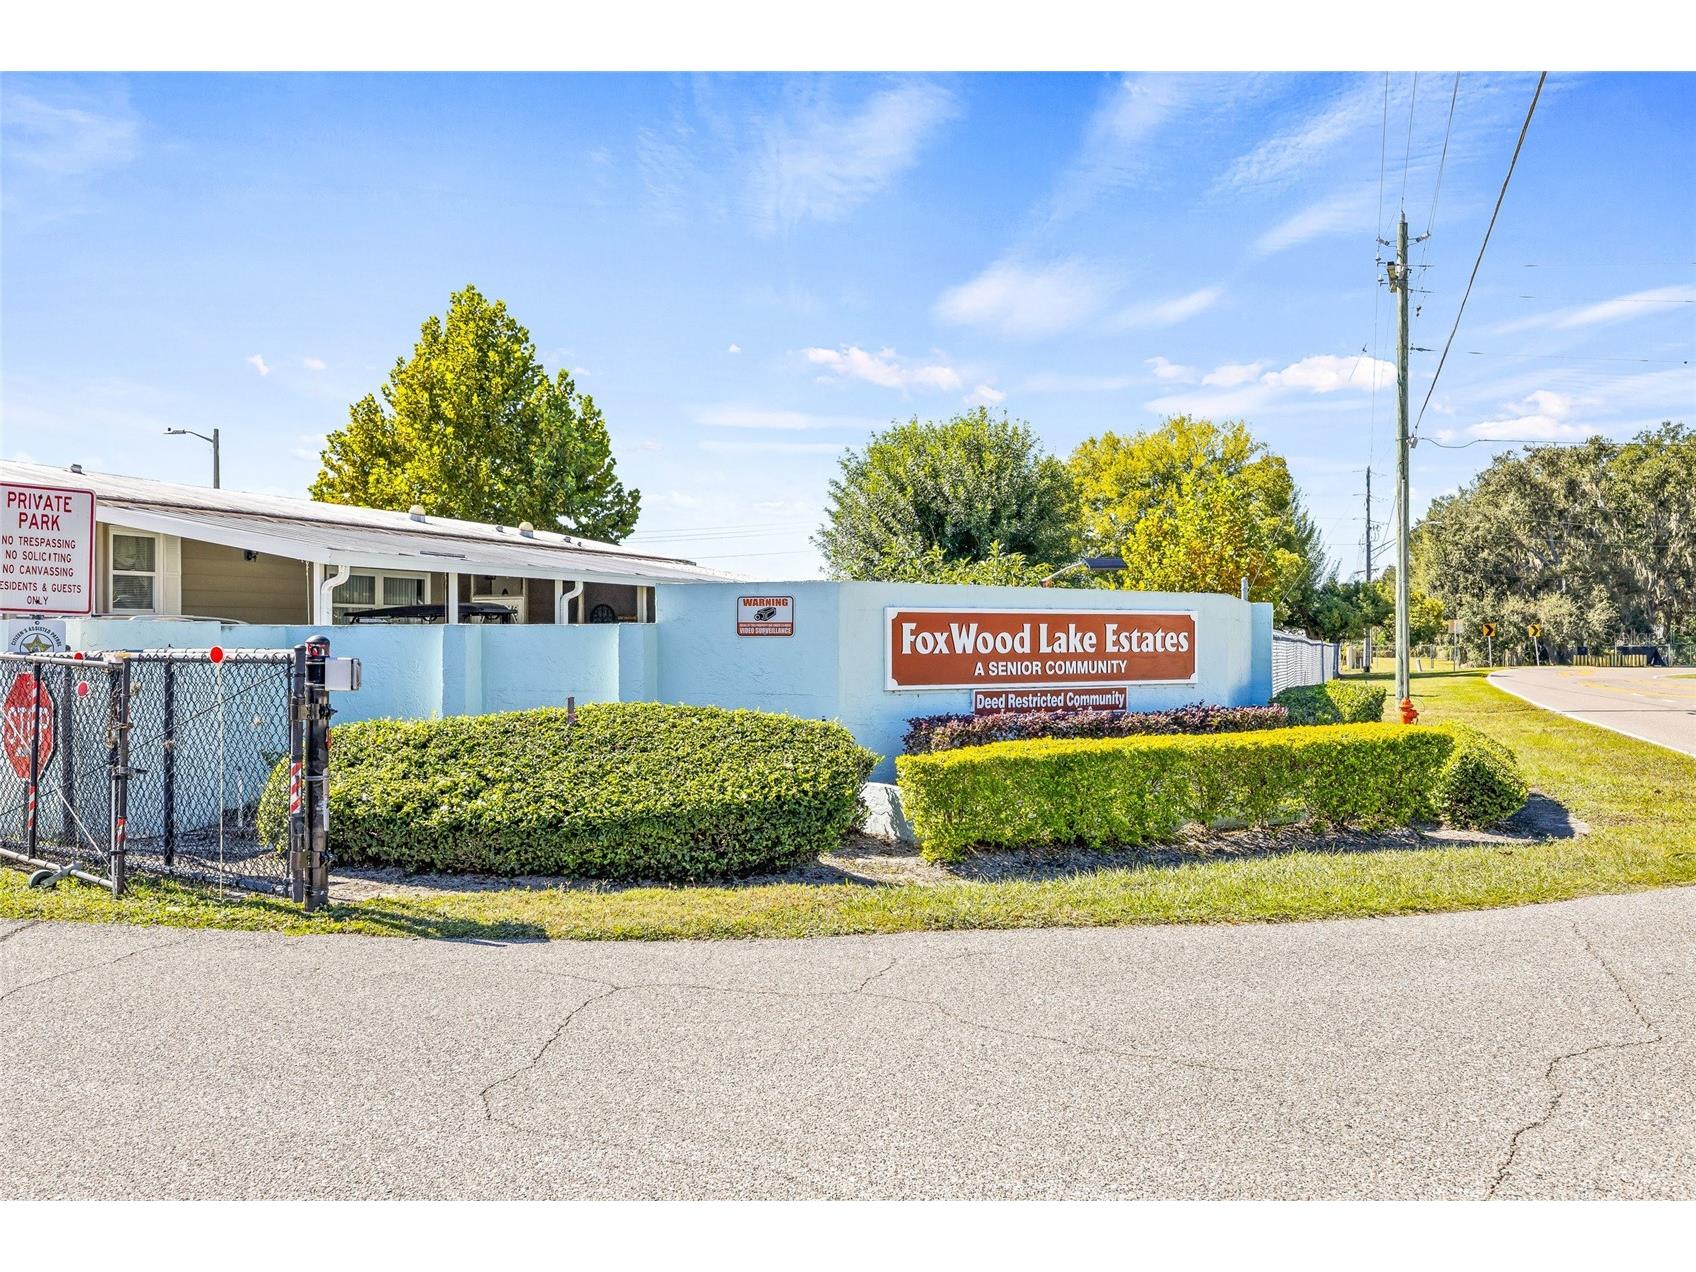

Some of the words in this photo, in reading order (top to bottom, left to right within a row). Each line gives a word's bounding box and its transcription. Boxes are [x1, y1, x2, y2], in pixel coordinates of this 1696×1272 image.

[7, 491, 73, 513] PRIVATE
[18, 512, 61, 532] PARK
[1, 535, 14, 545] NO
[19, 537, 76, 549] TRESPASSING
[5, 550, 18, 560] NO
[22, 551, 72, 563] SOLICITING
[2, 564, 15, 574] NO
[19, 565, 74, 577] CANVASSING
[0, 581, 38, 592] ESIDENTS
[41, 583, 47, 592] &
[51, 584, 82, 594] GUESTS
[26, 596, 49, 605] ONLY
[742, 598, 789, 607] WARNING
[28, 626, 51, 635] ASSISTED
[50, 631, 62, 647] PATROL
[901, 622, 1032, 655] FoxWood
[1038, 623, 1097, 654] Lake
[1105, 623, 1189, 653] Estates
[974, 662, 985, 676] A
[988, 661, 1042, 676] SENIOR
[1045, 660, 1128, 675] COMMUNITY
[976, 694, 1006, 709] Deed
[1008, 693, 1064, 708] Restricted
[1066, 690, 1126, 707] Community
